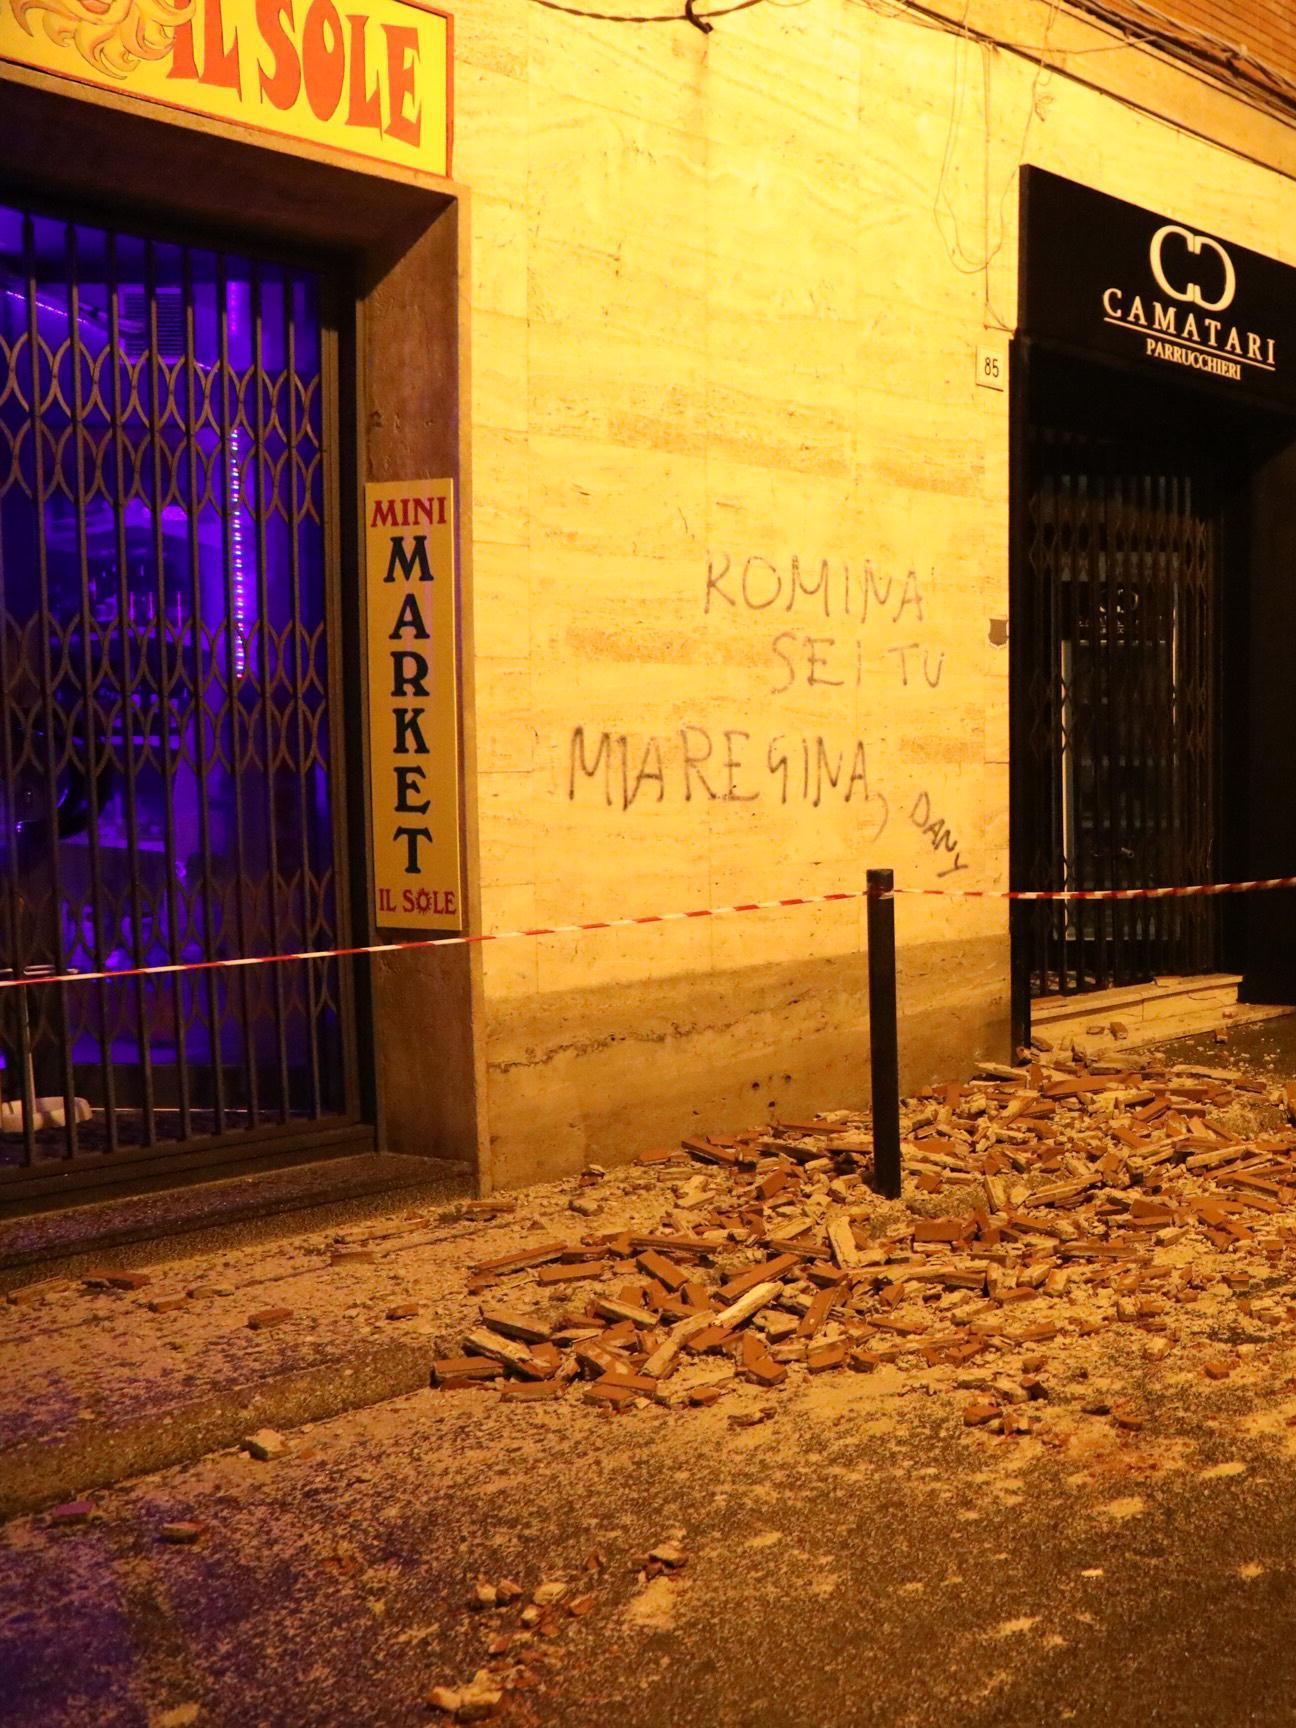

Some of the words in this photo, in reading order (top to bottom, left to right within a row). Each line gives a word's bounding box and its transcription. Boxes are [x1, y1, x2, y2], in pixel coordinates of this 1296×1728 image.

[166, 0, 242, 103] IL
[255, 0, 422, 148] SOLE
[1102, 288, 1276, 364] CAMATARI
[1146, 338, 1242, 380] PARRUCCHIERI
[984, 356, 1000, 378] 85
[370, 497, 447, 528] MINI
[704, 554, 924, 623] ROMINA
[769, 631, 863, 695] SEI
[887, 642, 945, 688] TU
[383, 535, 434, 874] MARKET
[909, 791, 969, 878] DANY
[378, 888, 397, 912] IL
[402, 887, 457, 915] SOLE
